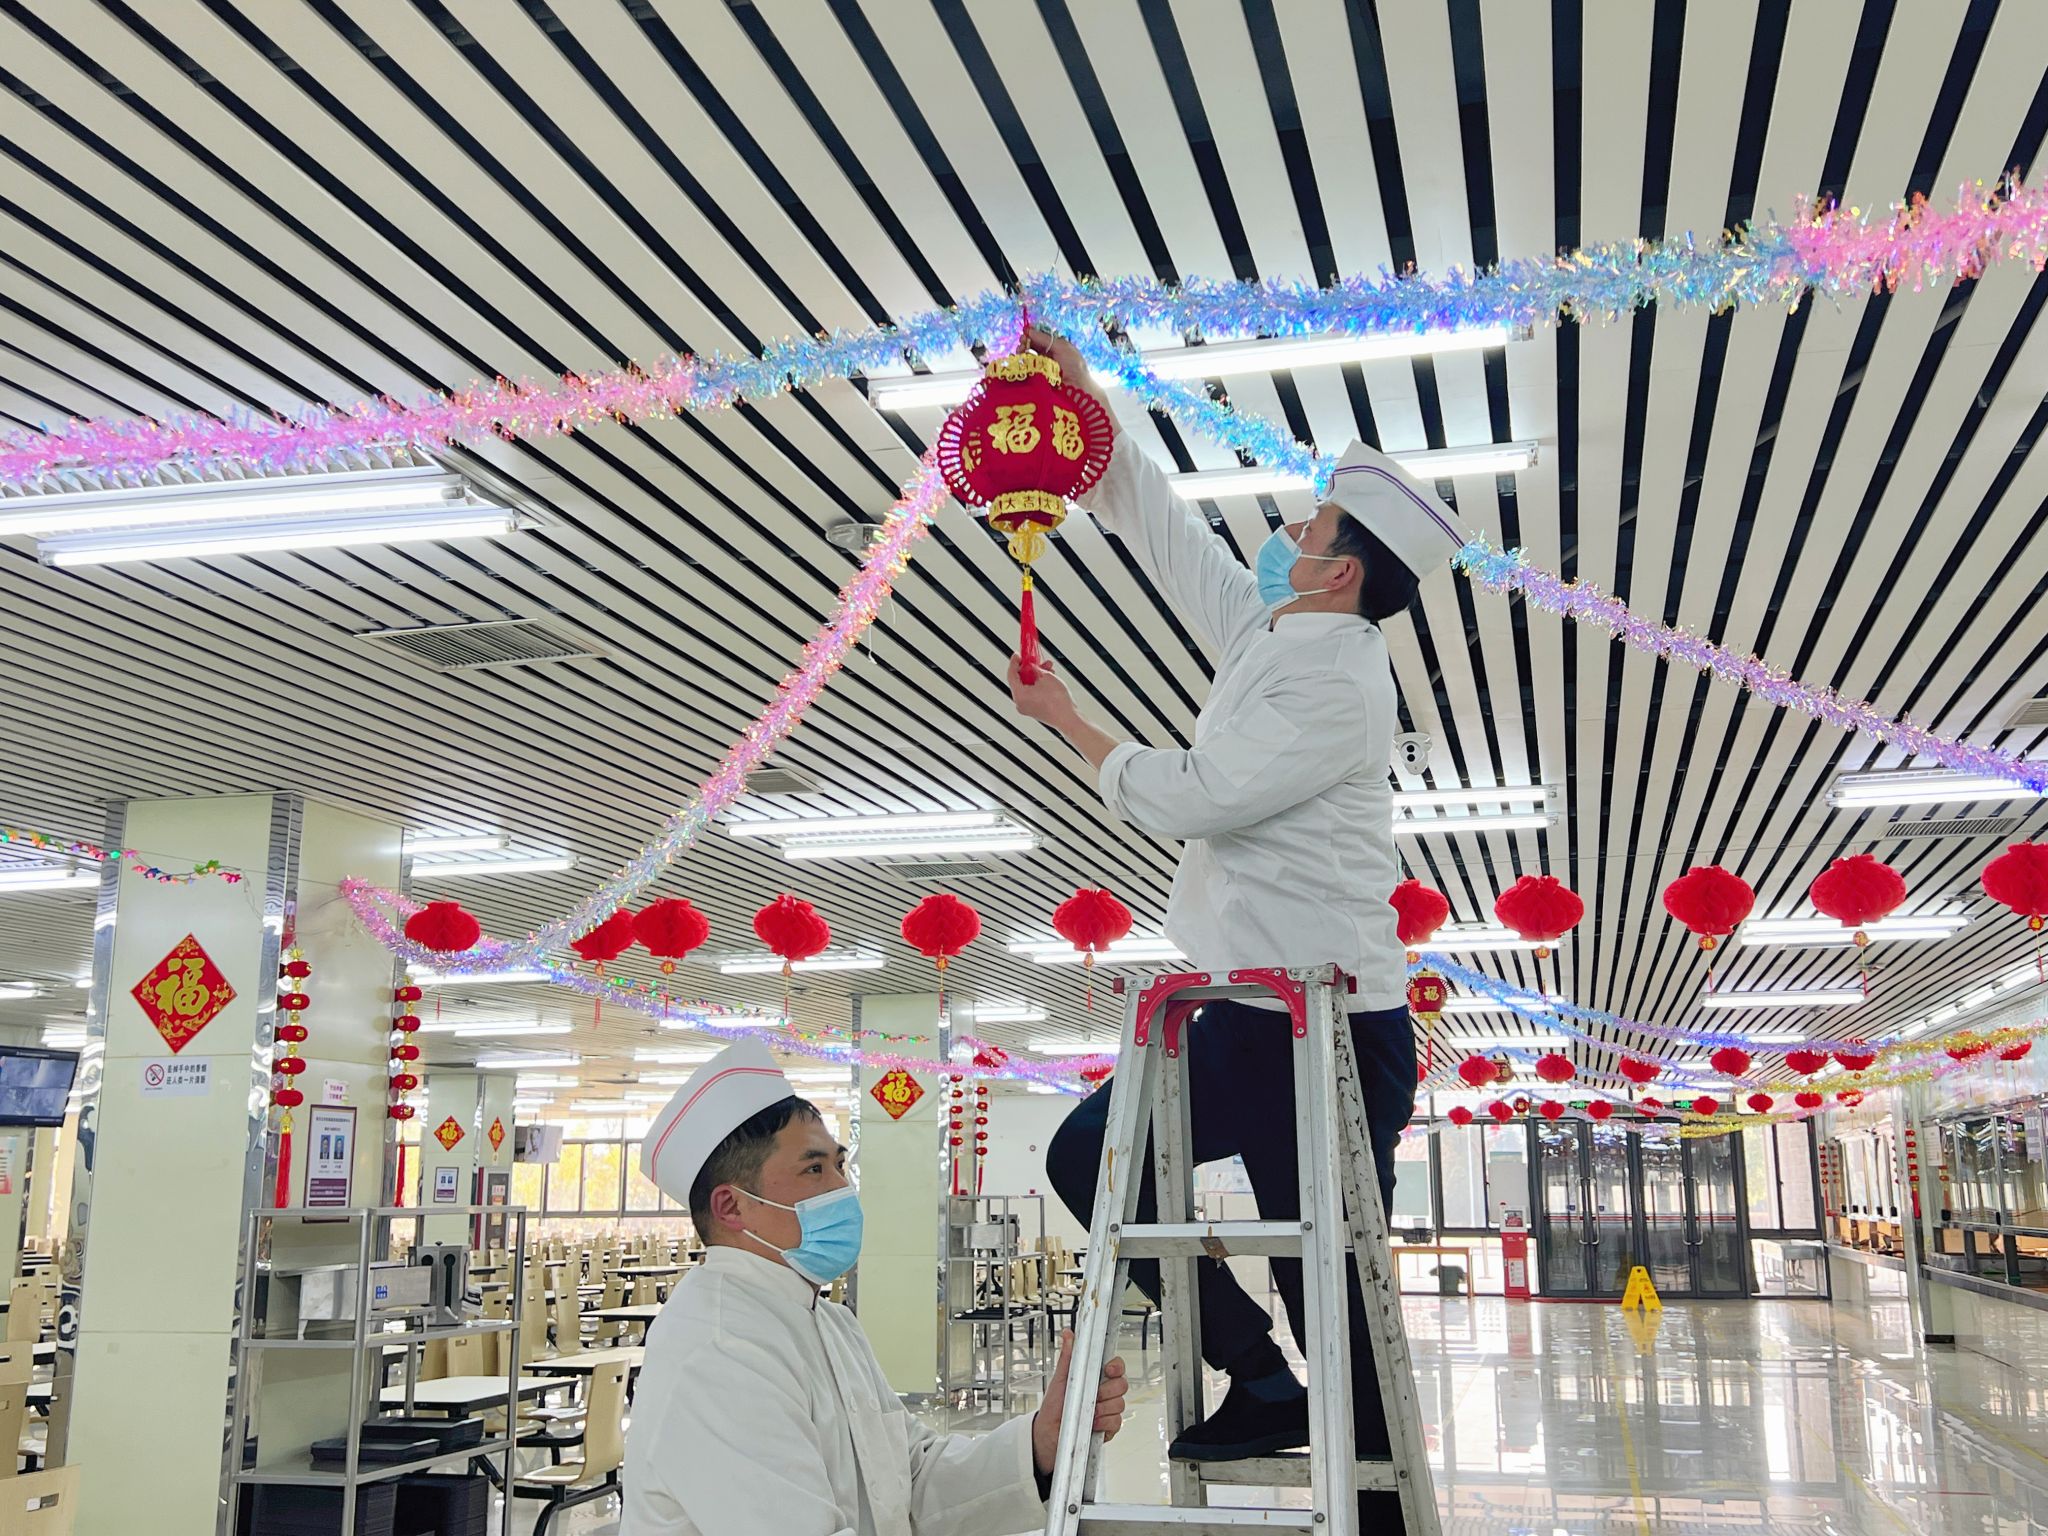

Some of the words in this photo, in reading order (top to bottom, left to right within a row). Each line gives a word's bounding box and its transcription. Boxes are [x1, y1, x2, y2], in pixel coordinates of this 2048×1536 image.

[987, 402, 1041, 455] 福
[1051, 404, 1085, 461] 福
[155, 957, 210, 1016] 福
[882, 1072, 911, 1103] 福
[440, 1121, 458, 1141] 福
